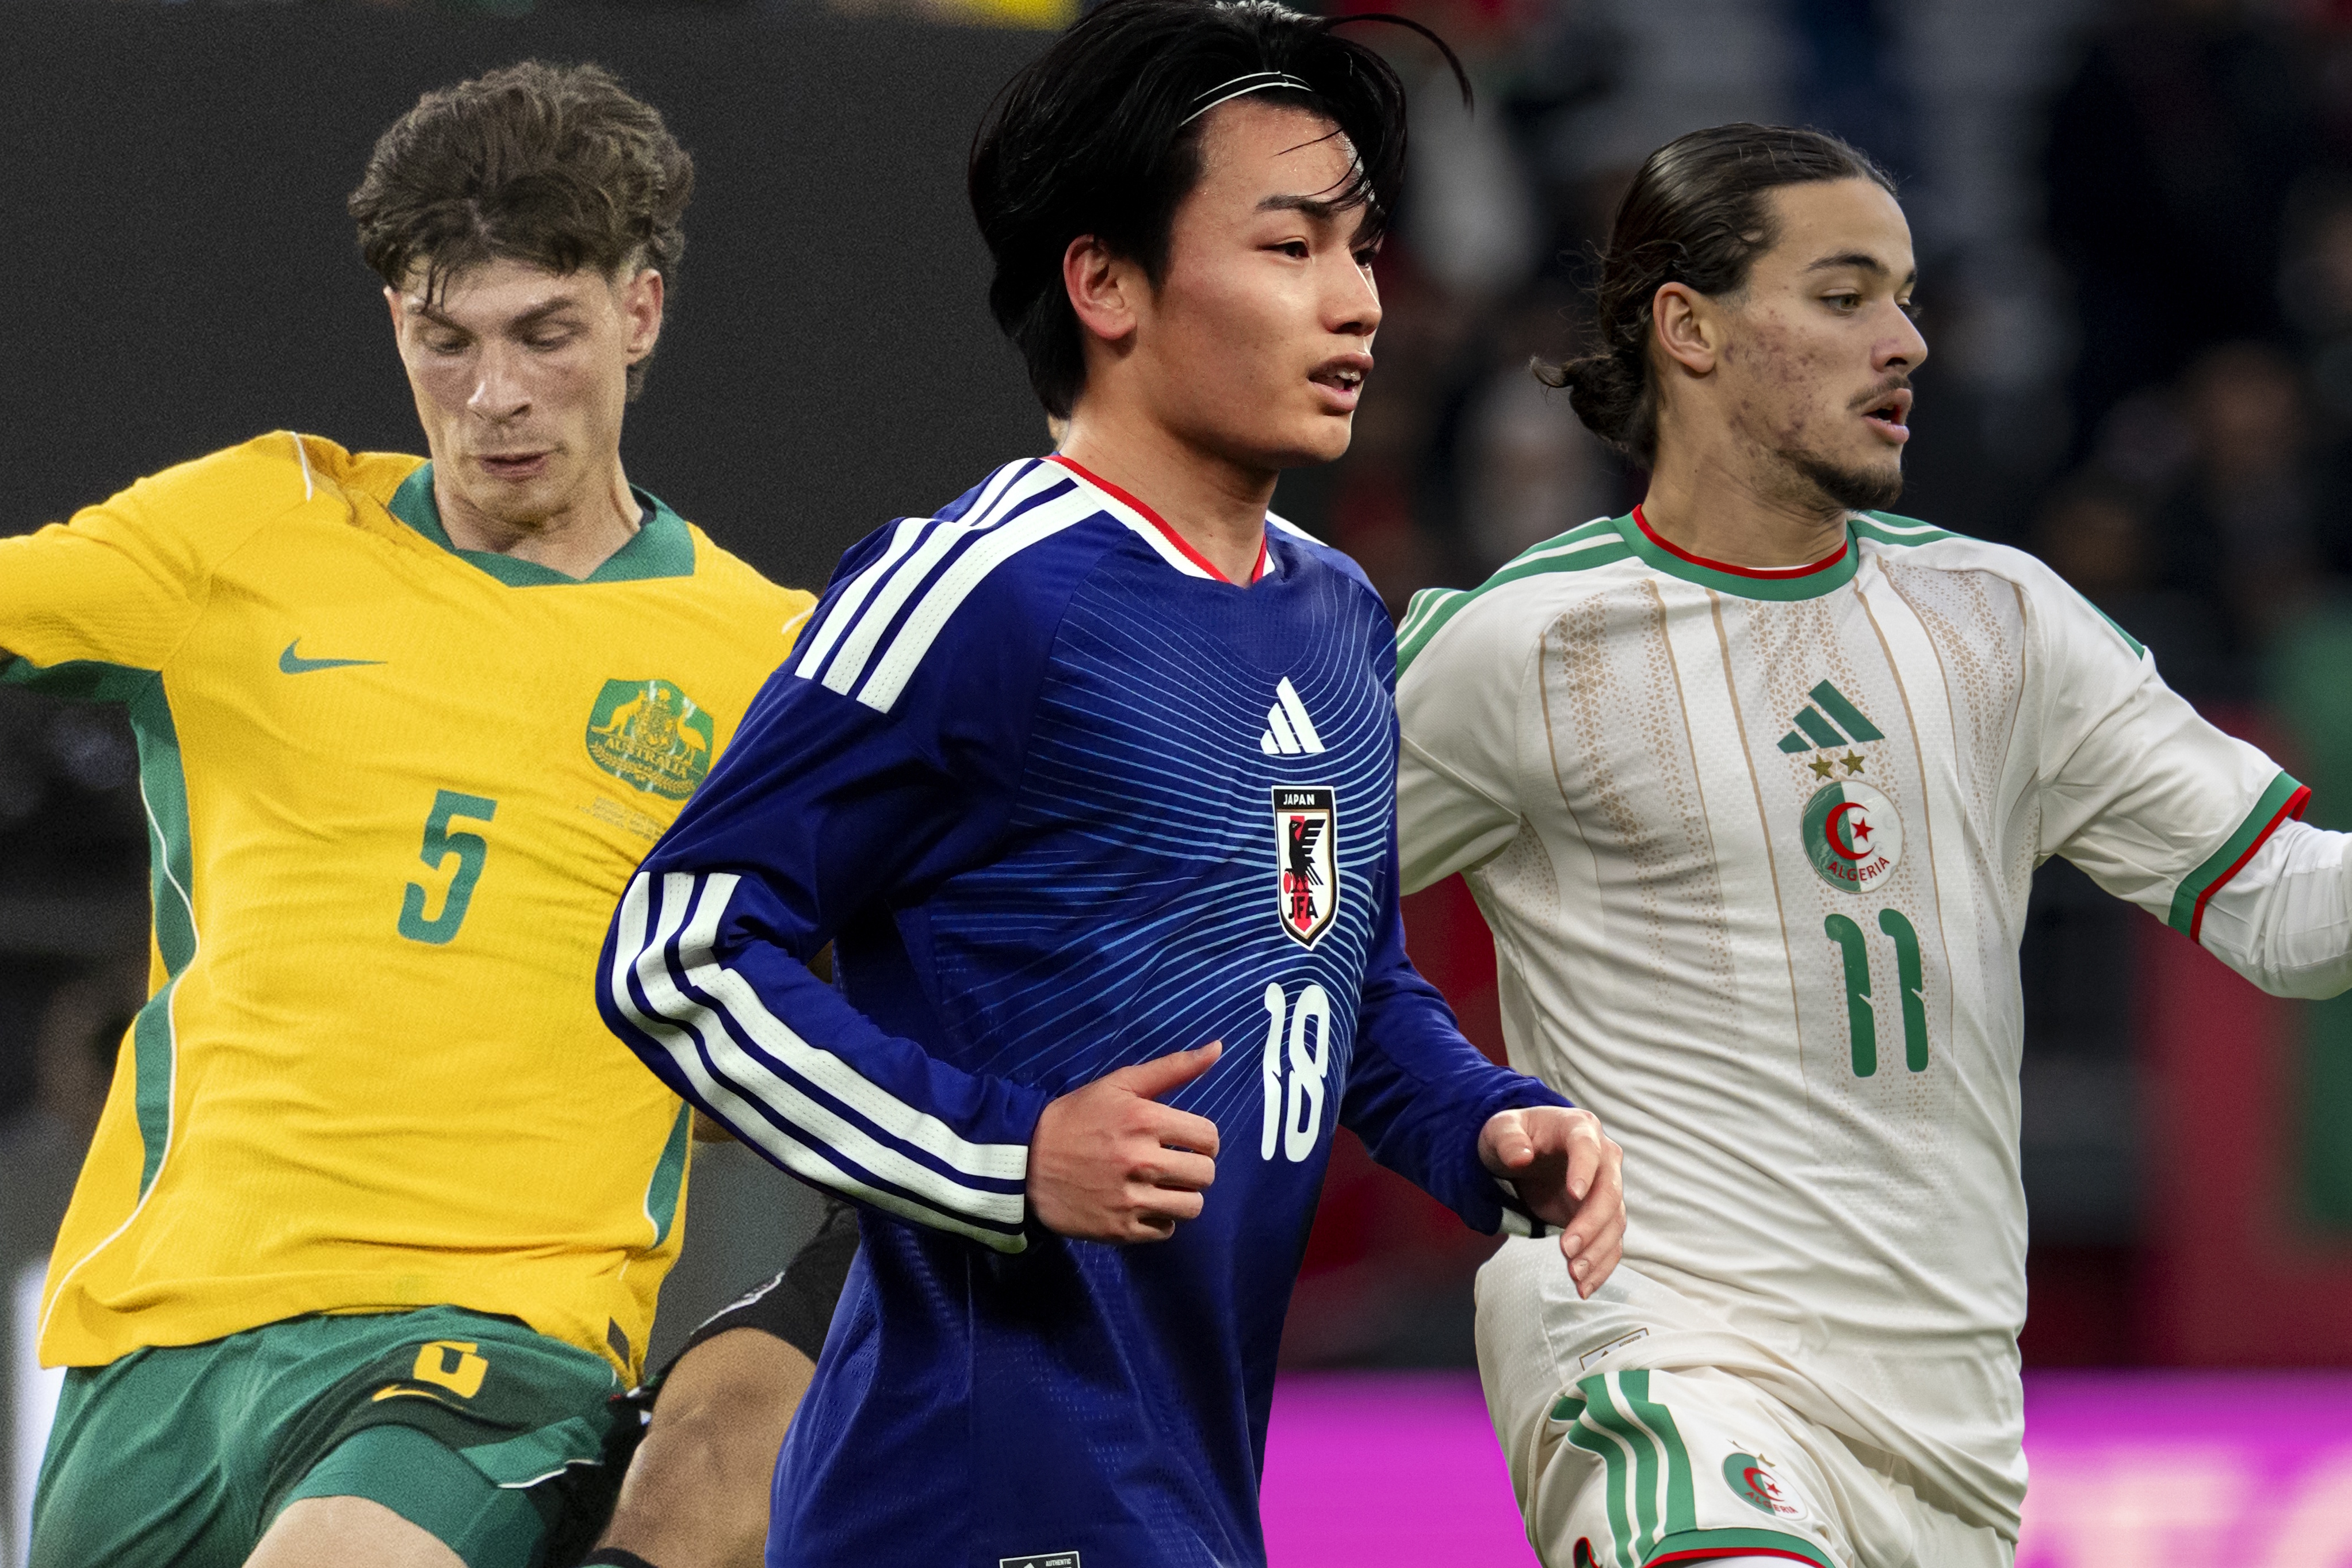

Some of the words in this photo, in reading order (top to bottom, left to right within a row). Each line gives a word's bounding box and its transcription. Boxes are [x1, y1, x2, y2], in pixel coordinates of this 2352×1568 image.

[603, 738, 689, 779] AUSTRALIA
[1283, 794, 1315, 805] JAPAN
[397, 789, 498, 946] 5
[1827, 856, 1890, 881] ALGERIA
[1288, 896, 1319, 919] JFA
[1824, 908, 1929, 1077] 11
[1261, 982, 1330, 1162] 18
[1745, 1491, 1799, 1514] ALGERIA
